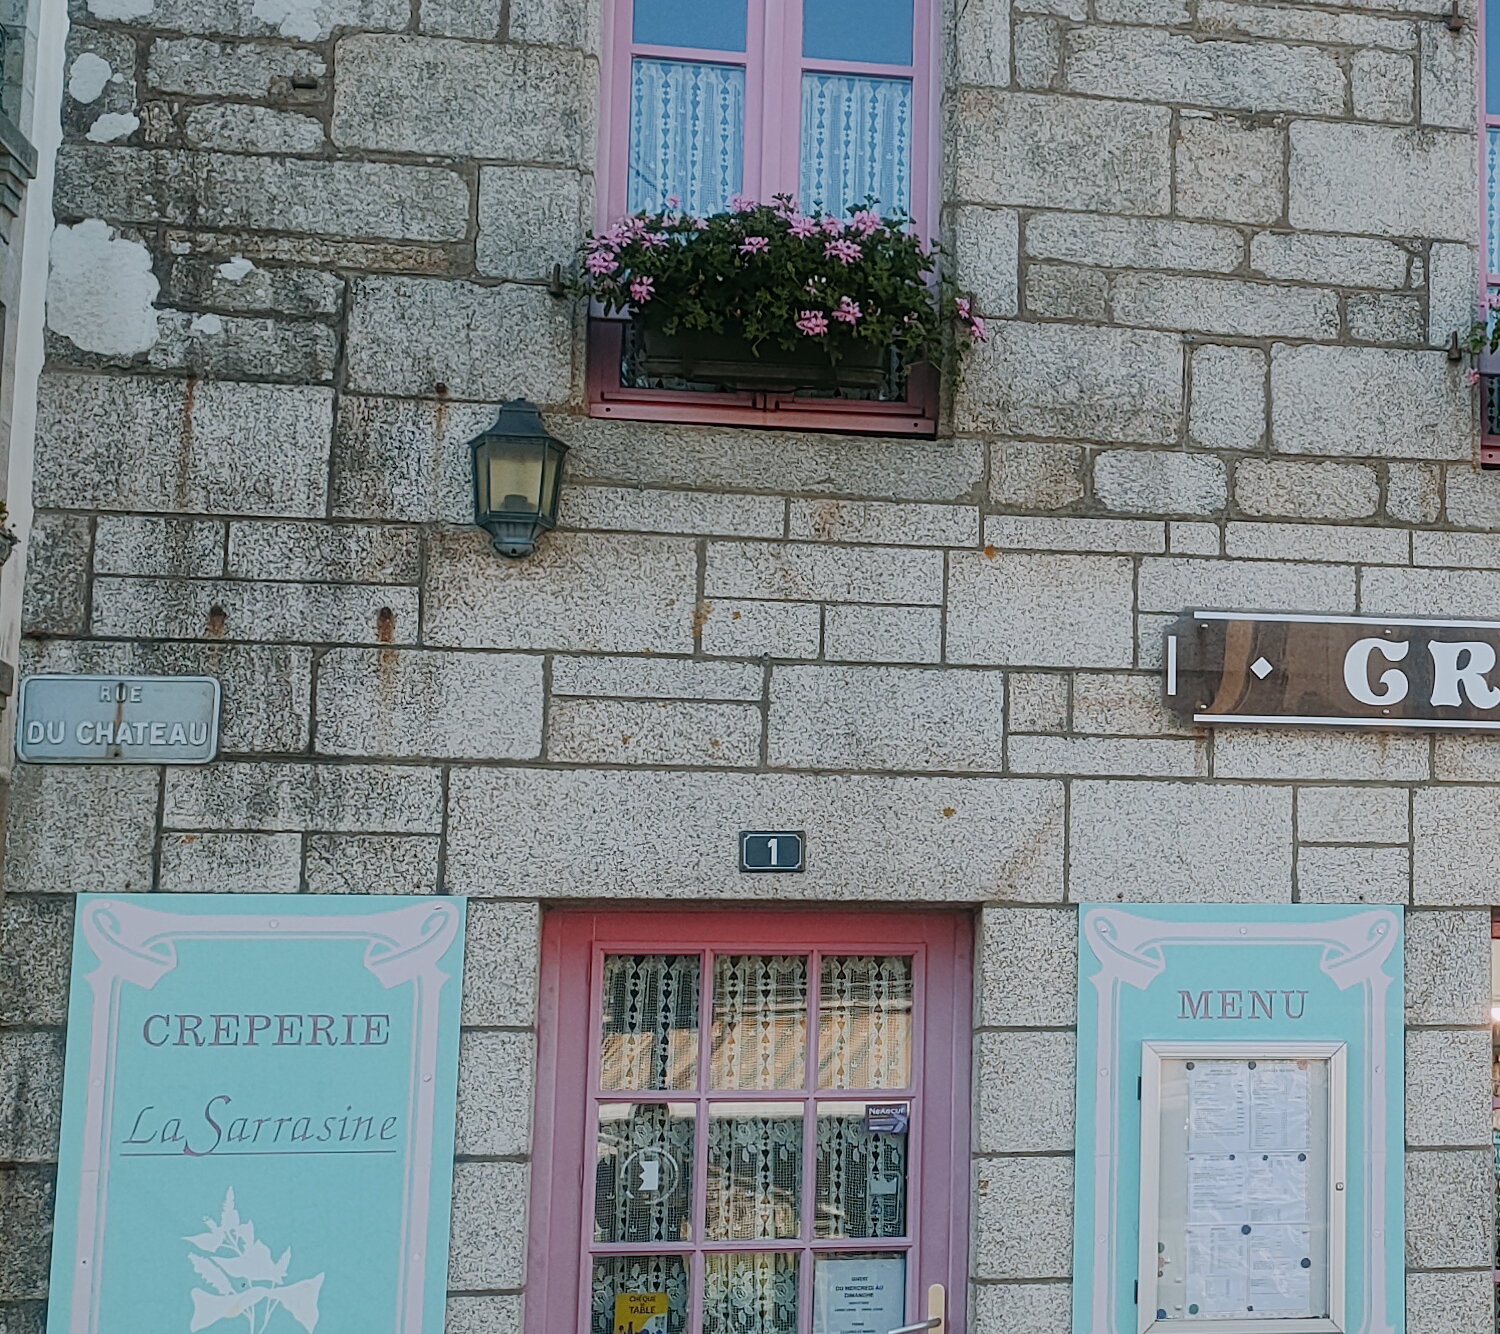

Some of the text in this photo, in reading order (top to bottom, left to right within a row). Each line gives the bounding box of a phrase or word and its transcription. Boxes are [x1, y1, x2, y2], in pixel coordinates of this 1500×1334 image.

[100, 685, 143, 703] RUE
[27, 720, 208, 746] DU CHATEAU
[767, 838, 778, 865] 1
[1177, 989, 1309, 1020] MENU
[142, 1014, 390, 1047] CREPERIE
[122, 1094, 398, 1157] La Sarrasine
[629, 1306, 656, 1314] TABLE
